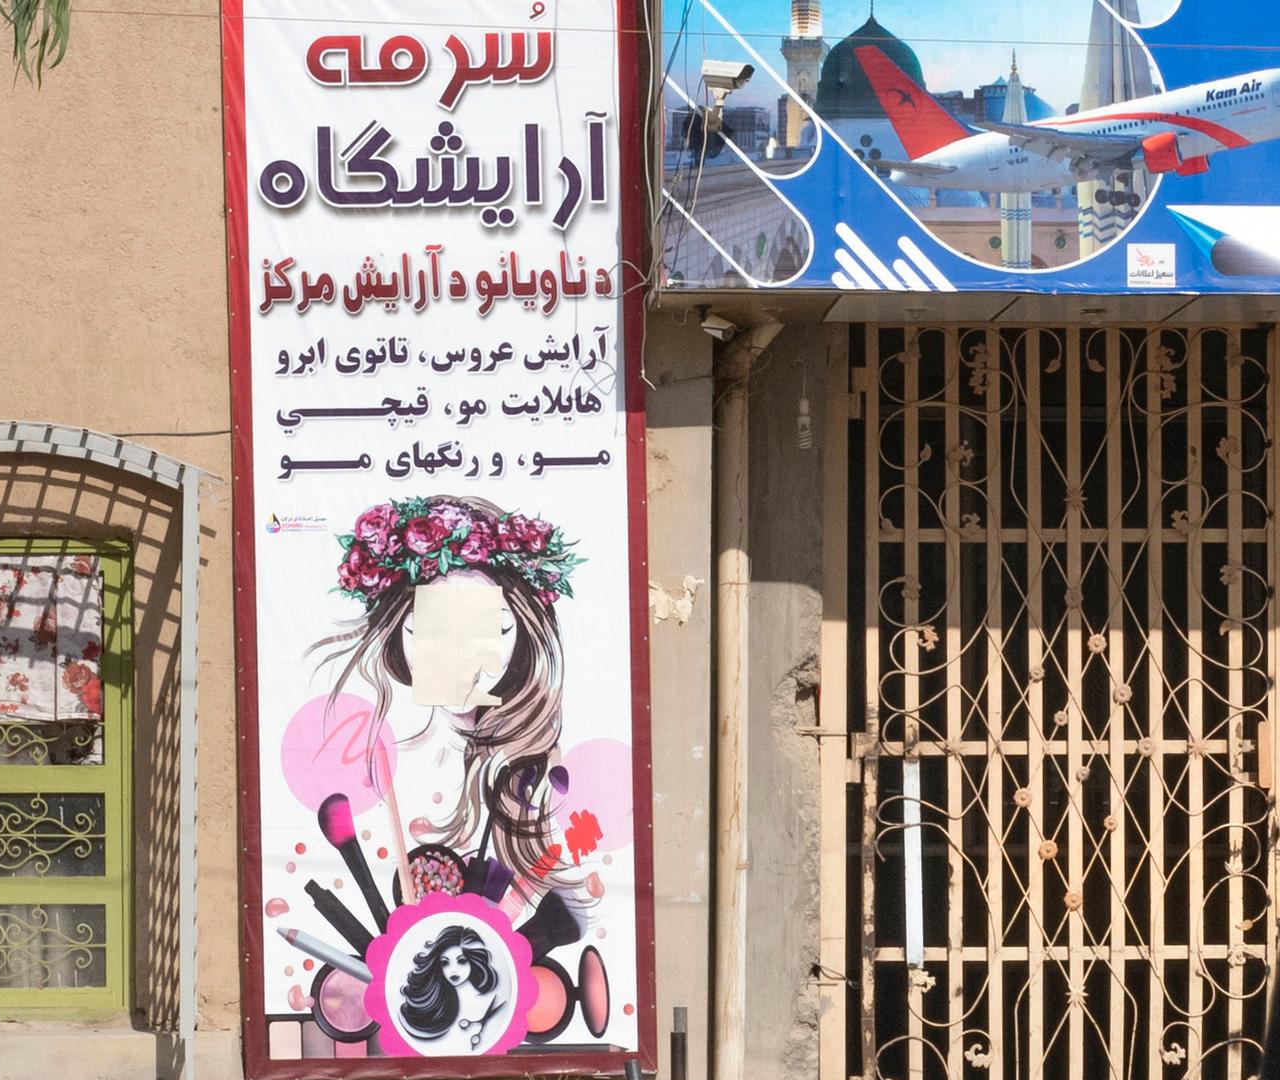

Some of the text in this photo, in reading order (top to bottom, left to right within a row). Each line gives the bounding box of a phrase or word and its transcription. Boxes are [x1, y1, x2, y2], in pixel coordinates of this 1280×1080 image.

[1206, 79, 1262, 102] Kam Air
[259, 110, 607, 230] آرایشگاه
[259, 243, 613, 317] د ناویانو د آرایش مرکز
[275, 326, 610, 375] آرایش عروس، تاتوی ابرو
[444, 398, 488, 425] مو،
[501, 385, 603, 422] هایلایت
[385, 440, 480, 478] رنگهای
[489, 451, 504, 477] و
